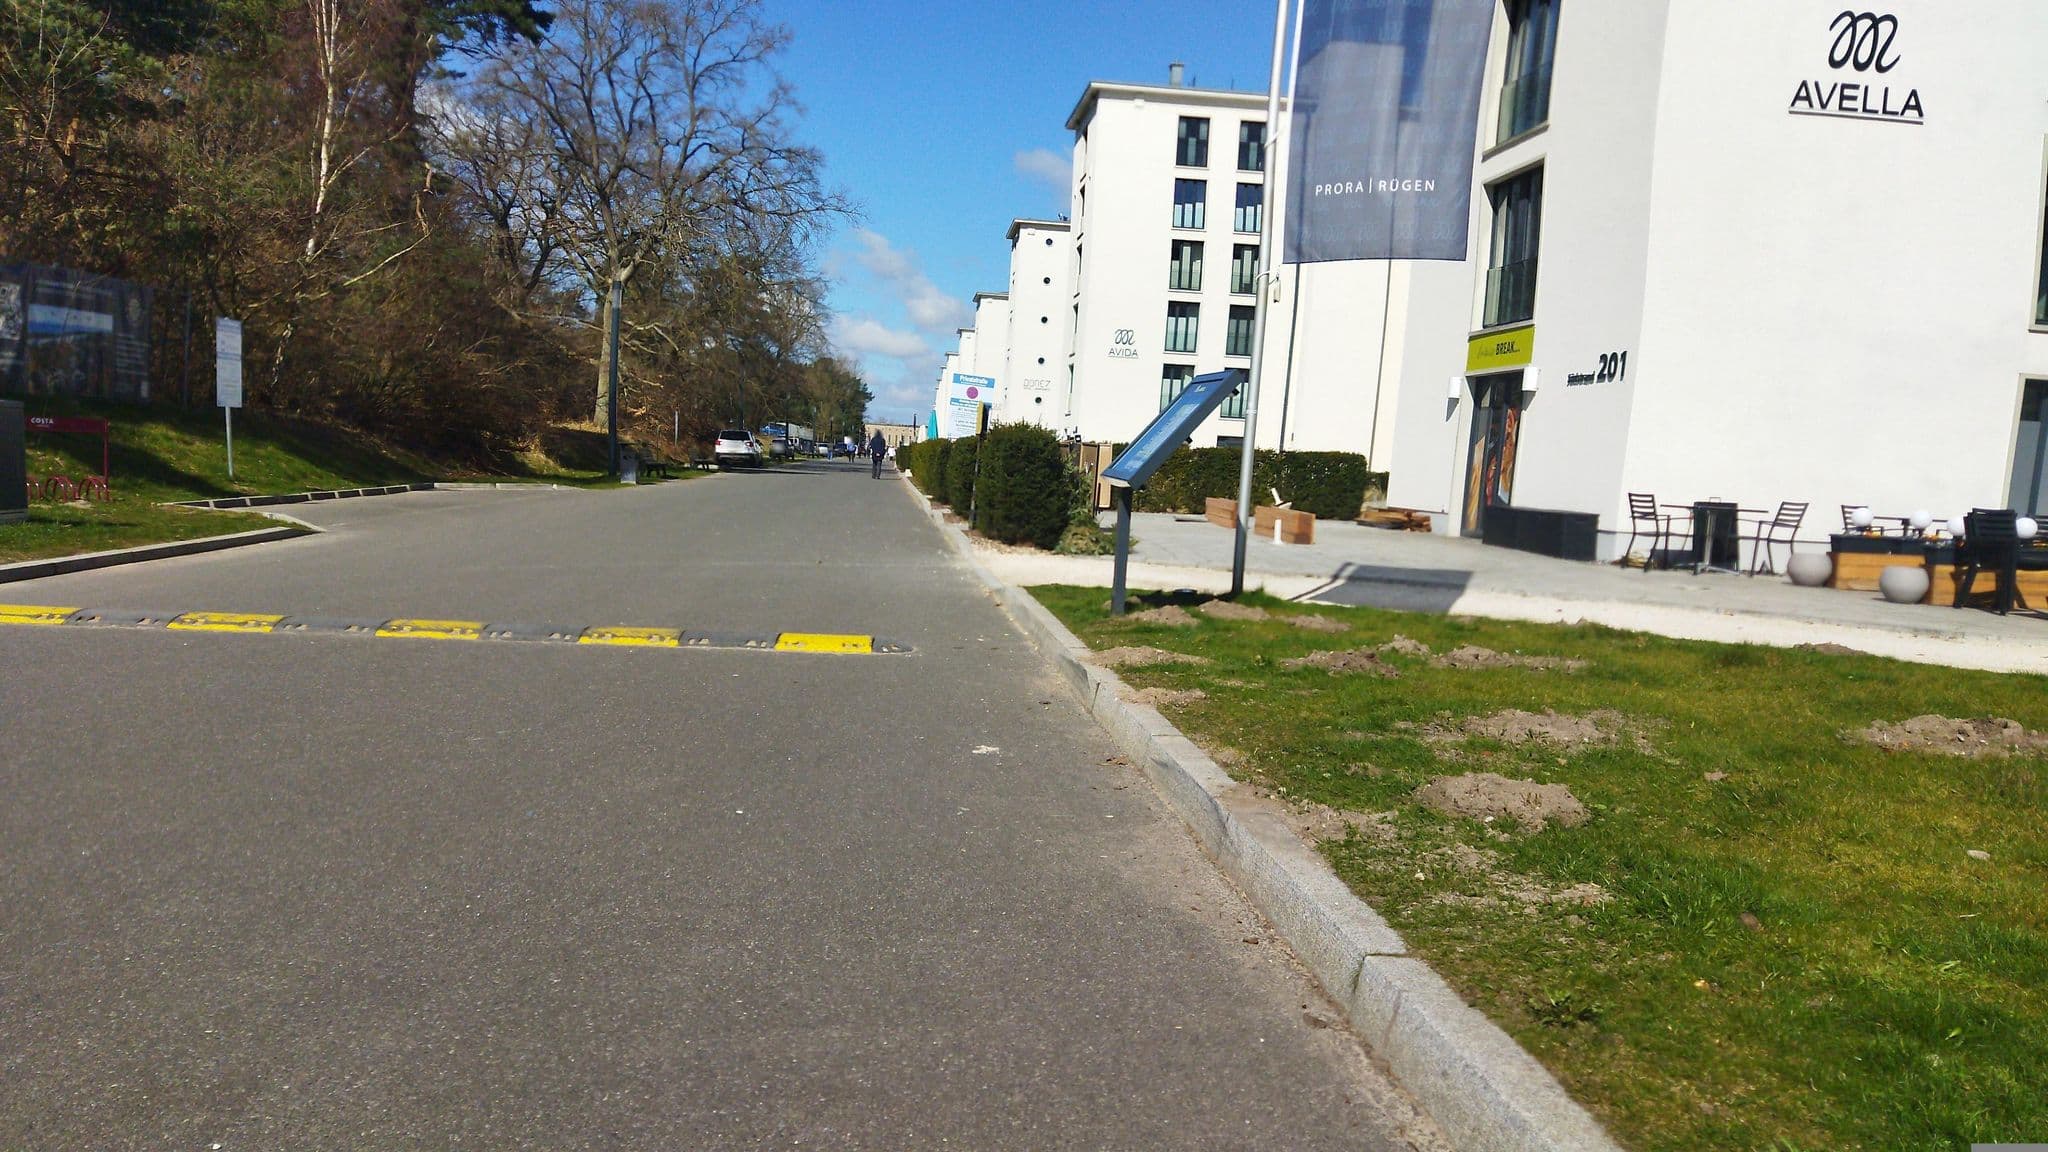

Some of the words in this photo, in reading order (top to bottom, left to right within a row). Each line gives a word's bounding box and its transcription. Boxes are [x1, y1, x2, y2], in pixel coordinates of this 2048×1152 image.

[1790, 79, 1924, 118] AVELLA
[1315, 180, 1364, 197] PRORA
[1378, 176, 1436, 192] RÜGEN
[1108, 347, 1139, 357] AVIDA
[1596, 350, 1628, 384] 201
[30, 416, 54, 424] COSTA
